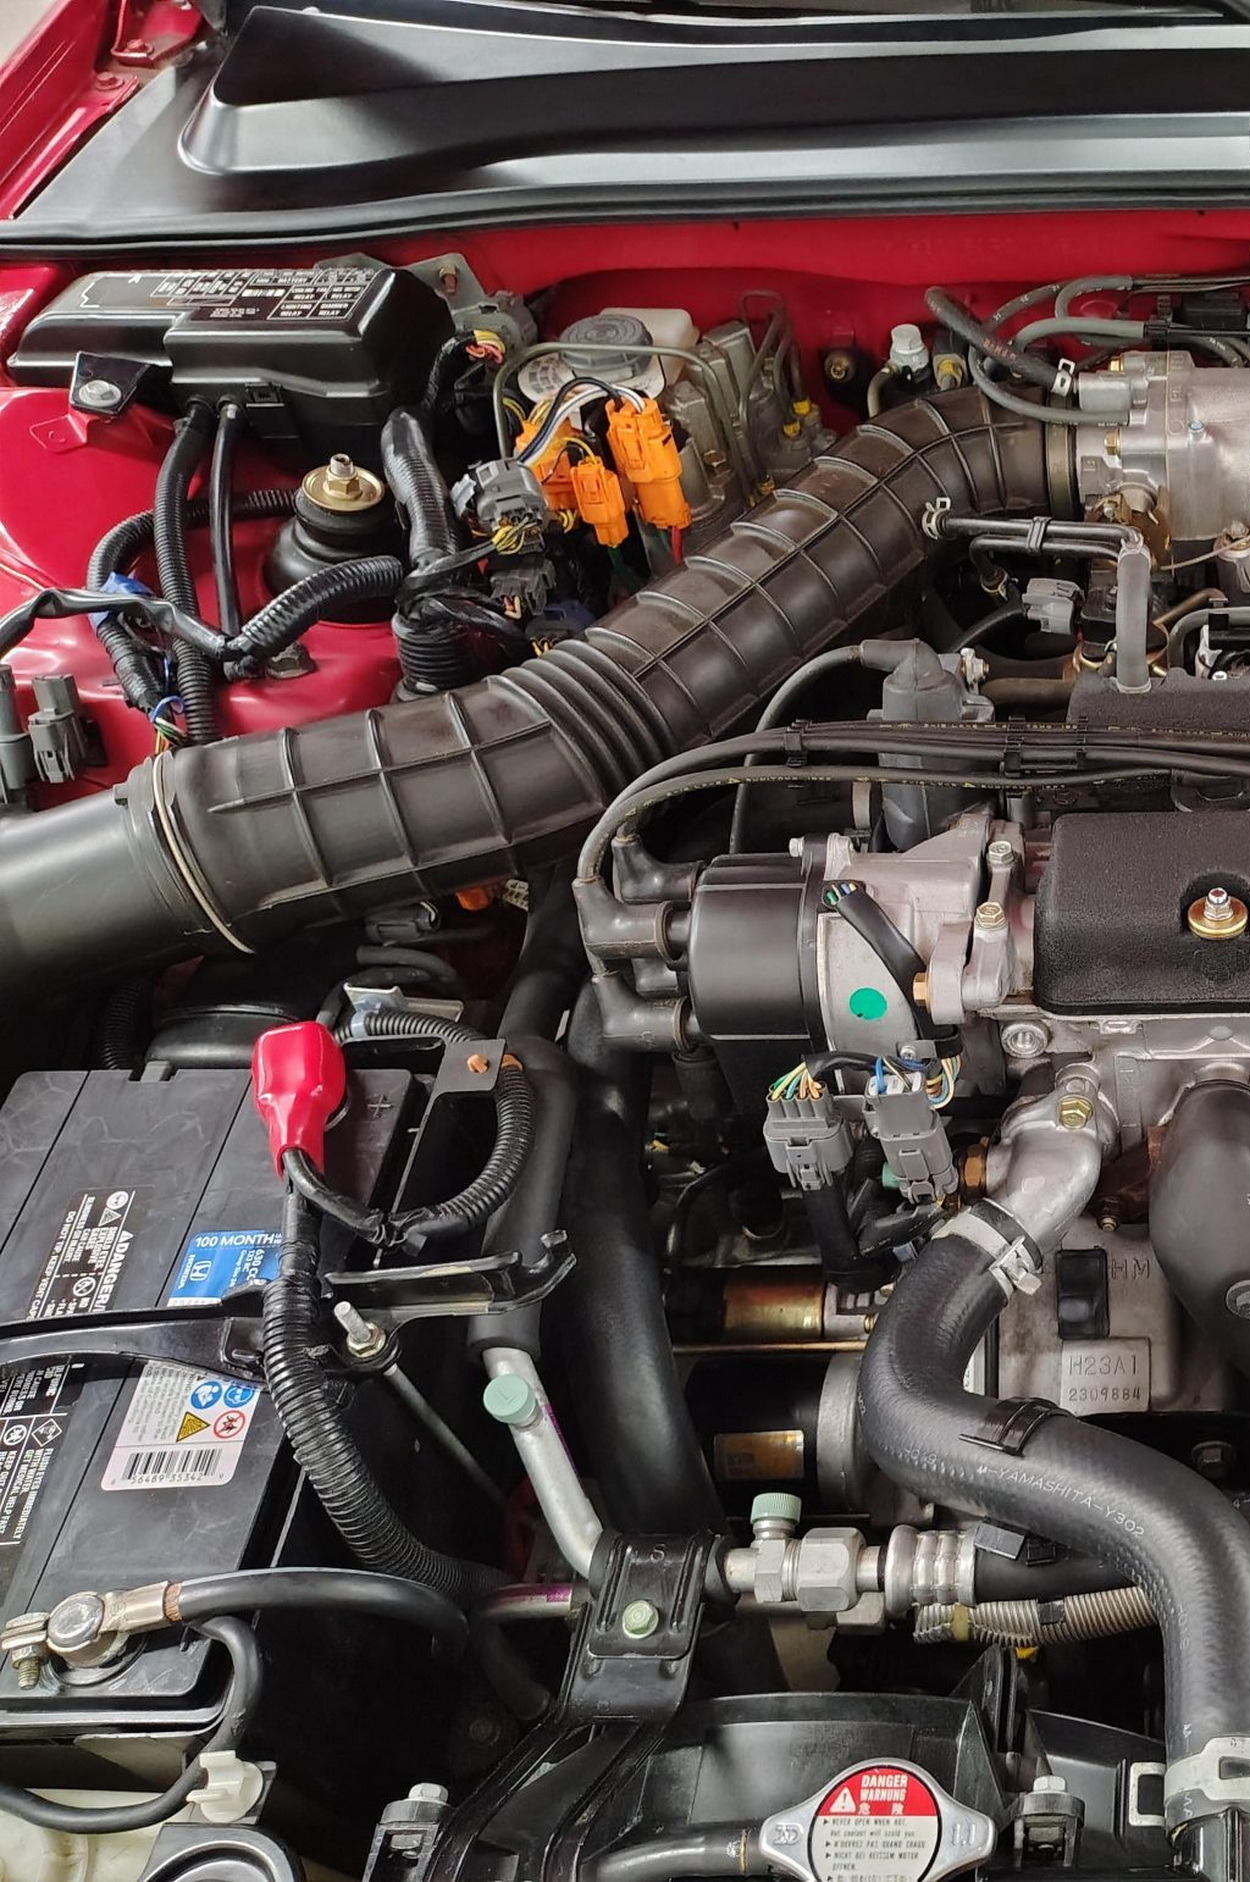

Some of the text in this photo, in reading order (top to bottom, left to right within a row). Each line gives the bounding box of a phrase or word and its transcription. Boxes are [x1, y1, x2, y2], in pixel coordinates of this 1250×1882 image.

[66, 1211, 76, 1222] DO
[59, 1224, 70, 1239] NOT
[195, 1236, 219, 1247] 100
[220, 1233, 274, 1246] MONTH
[252, 1249, 265, 1266] 630
[92, 1242, 129, 1311] DANGER/
[178, 1254, 195, 1289] HONDA
[1111, 1258, 1151, 1280] HM
[1068, 1354, 1137, 1376] H23A1
[1068, 1386, 1141, 1402] 2309884
[131, 1473, 165, 1485] 56489
[169, 1471, 204, 1483] 35342
[861, 1774, 909, 1788] DANGER
[860, 1788, 907, 1801] WARNUNG
[854, 1818, 870, 1826] OPEN
